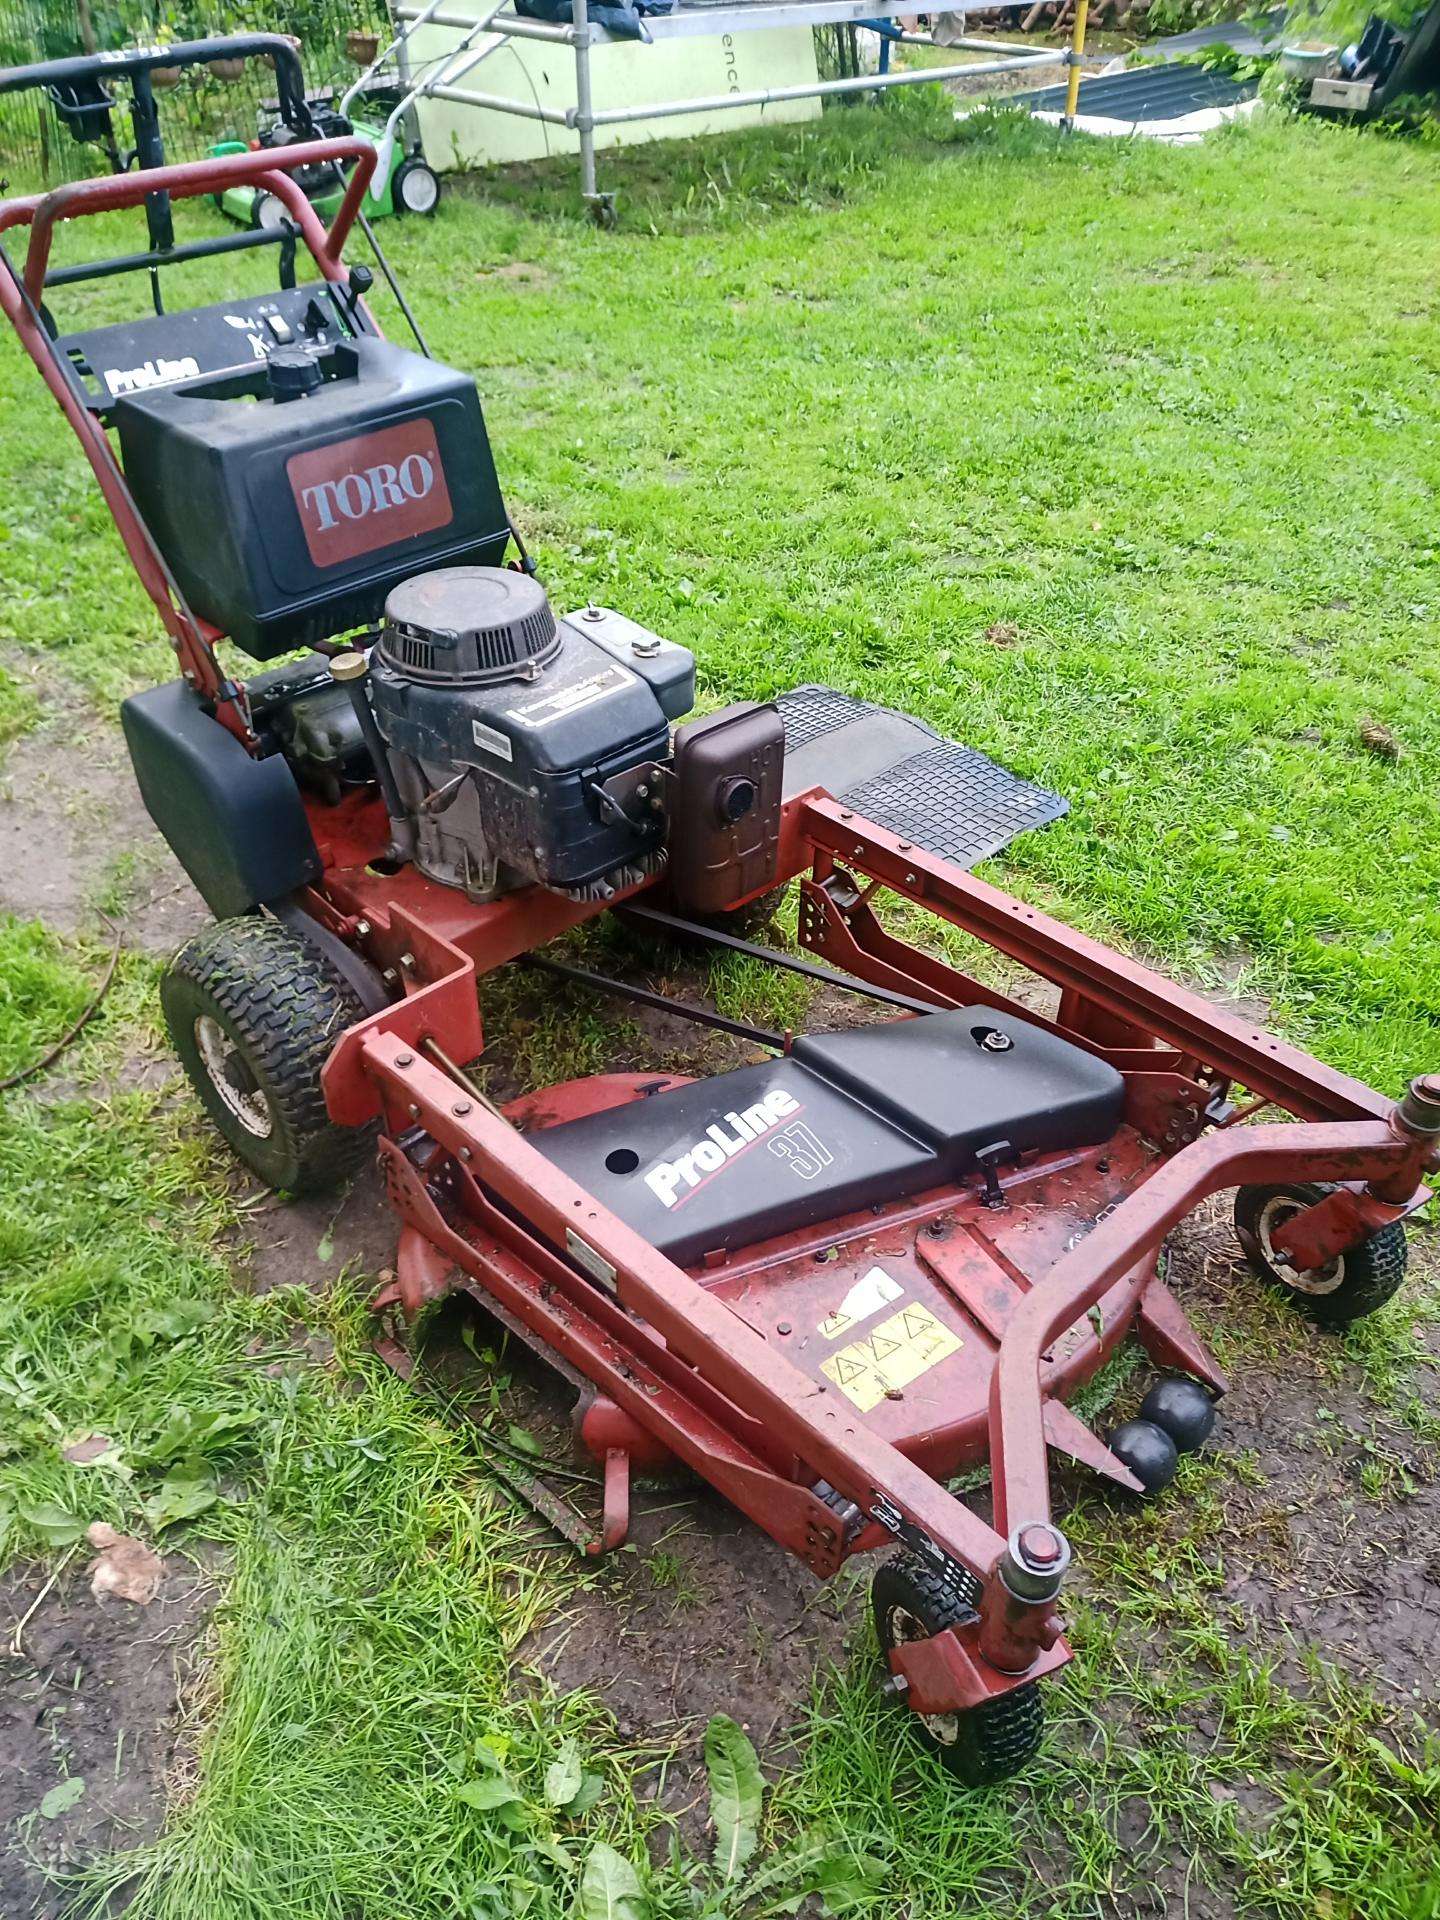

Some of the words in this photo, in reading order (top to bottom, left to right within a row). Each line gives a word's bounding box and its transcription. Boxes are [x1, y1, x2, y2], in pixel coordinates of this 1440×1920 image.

[104, 357, 200, 395] ProLine
[302, 454, 434, 532] TORO
[644, 1090, 800, 1208] ProLine
[767, 1120, 834, 1190] 37
